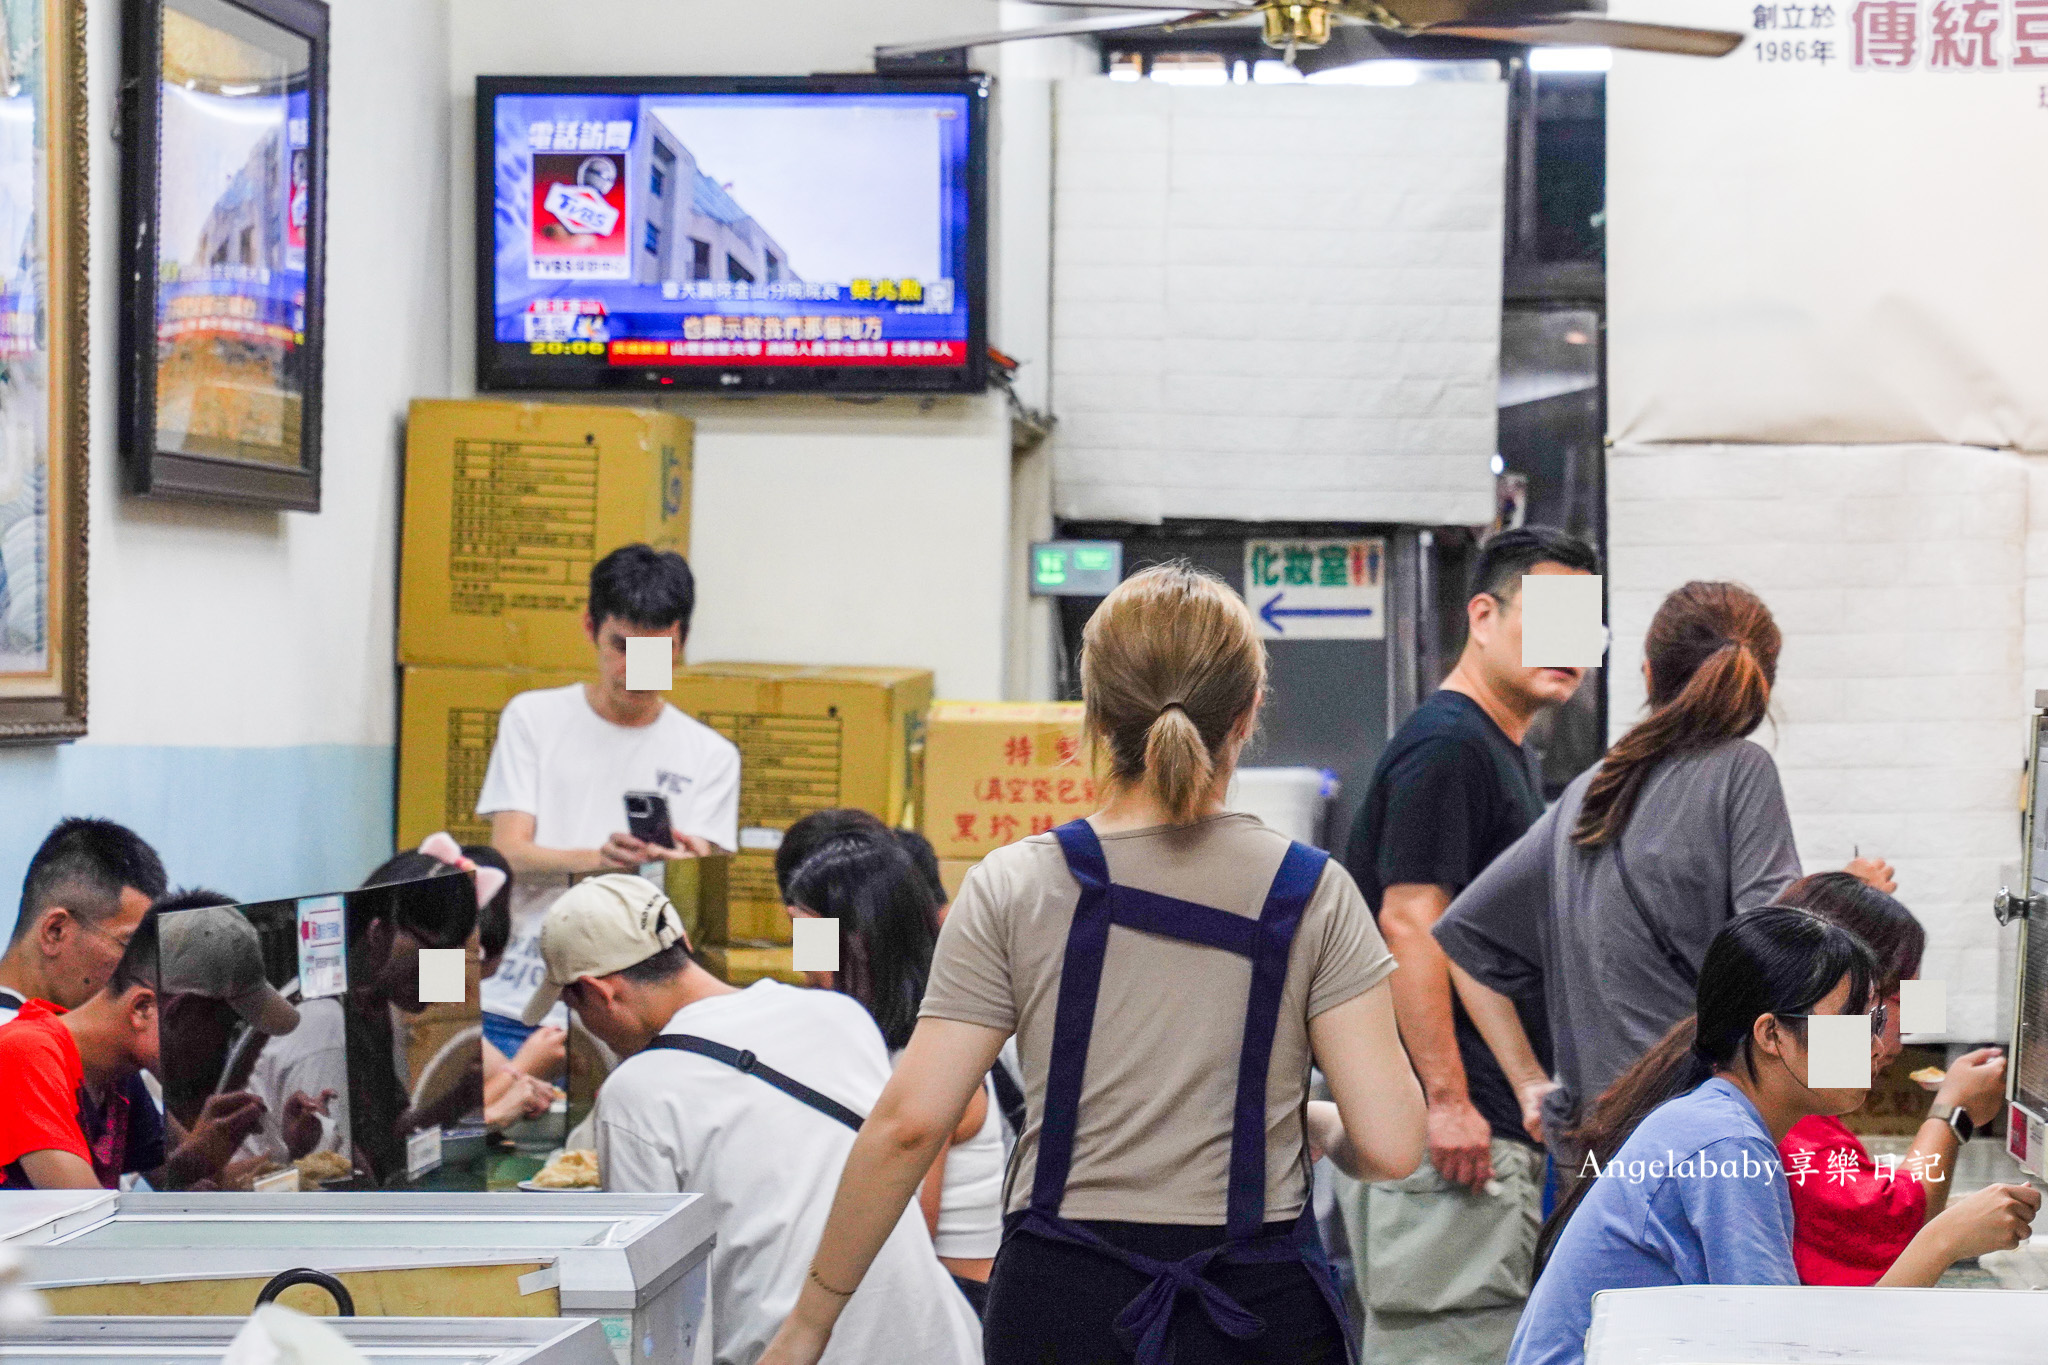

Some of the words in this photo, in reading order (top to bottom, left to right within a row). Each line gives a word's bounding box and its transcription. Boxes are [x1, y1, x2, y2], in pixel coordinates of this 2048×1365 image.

[1752, 4, 1835, 30] 創立於
[1755, 40, 1835, 65] 1986年
[530, 340, 605, 355] 20:06
